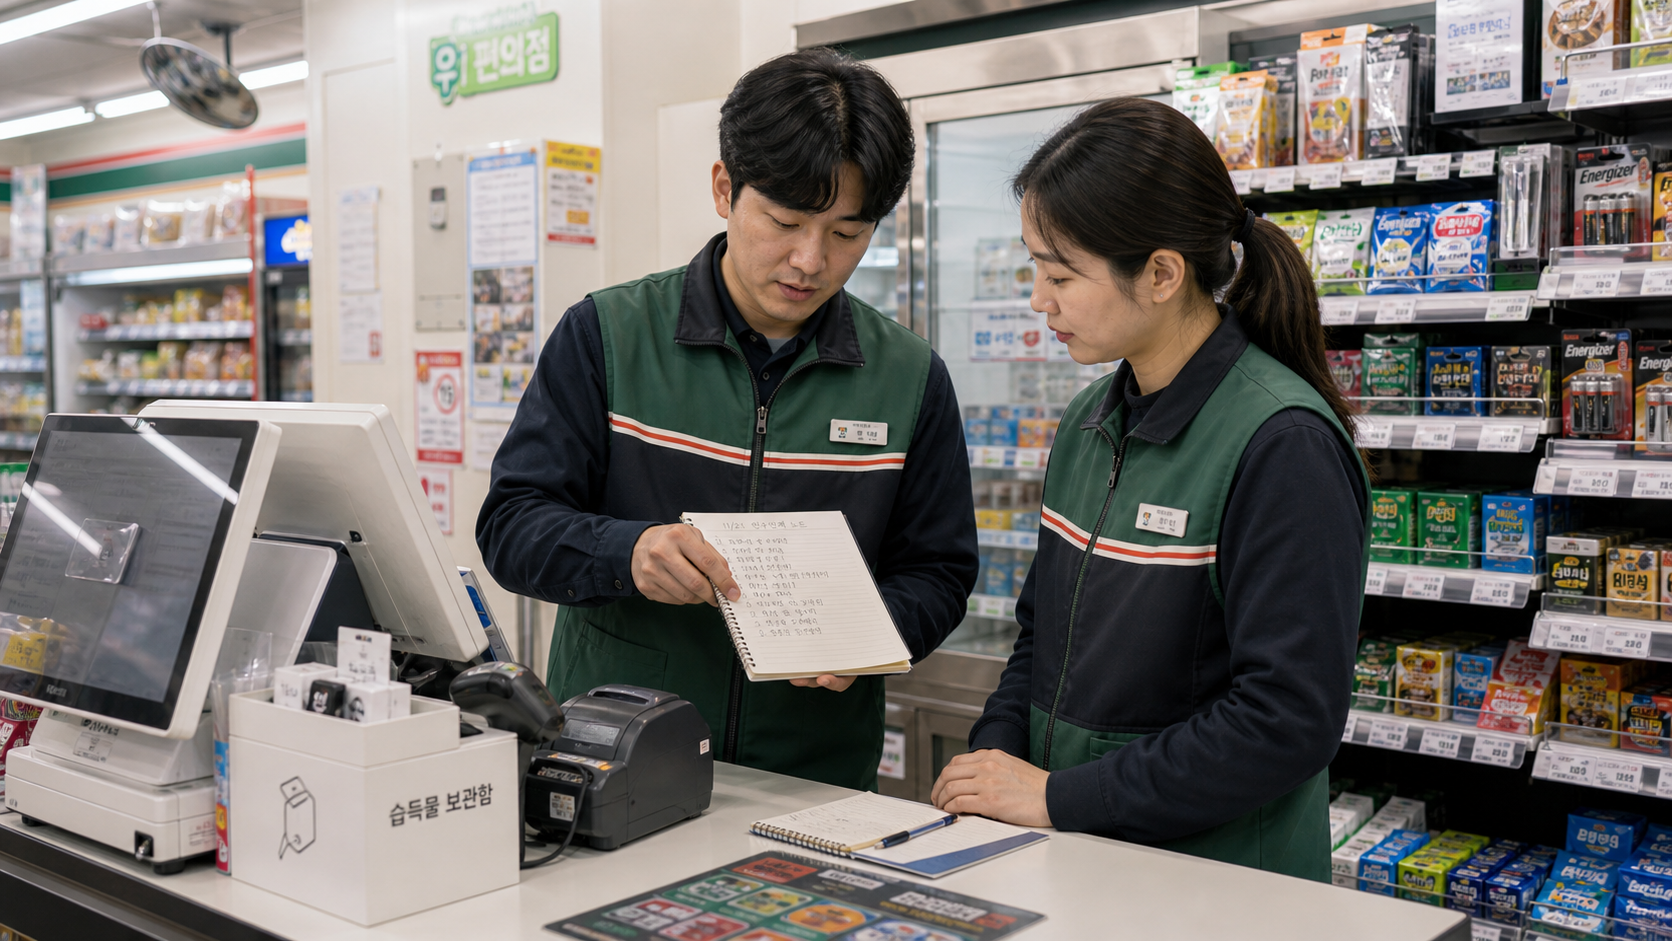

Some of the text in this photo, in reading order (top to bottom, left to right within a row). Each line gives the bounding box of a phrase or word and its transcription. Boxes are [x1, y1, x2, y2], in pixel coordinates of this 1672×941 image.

[473, 25, 550, 84] 편의점
[1579, 164, 1637, 184] Energizer
[1564, 342, 1615, 360] Energizer
[389, 783, 493, 827] 습득물 보관함
